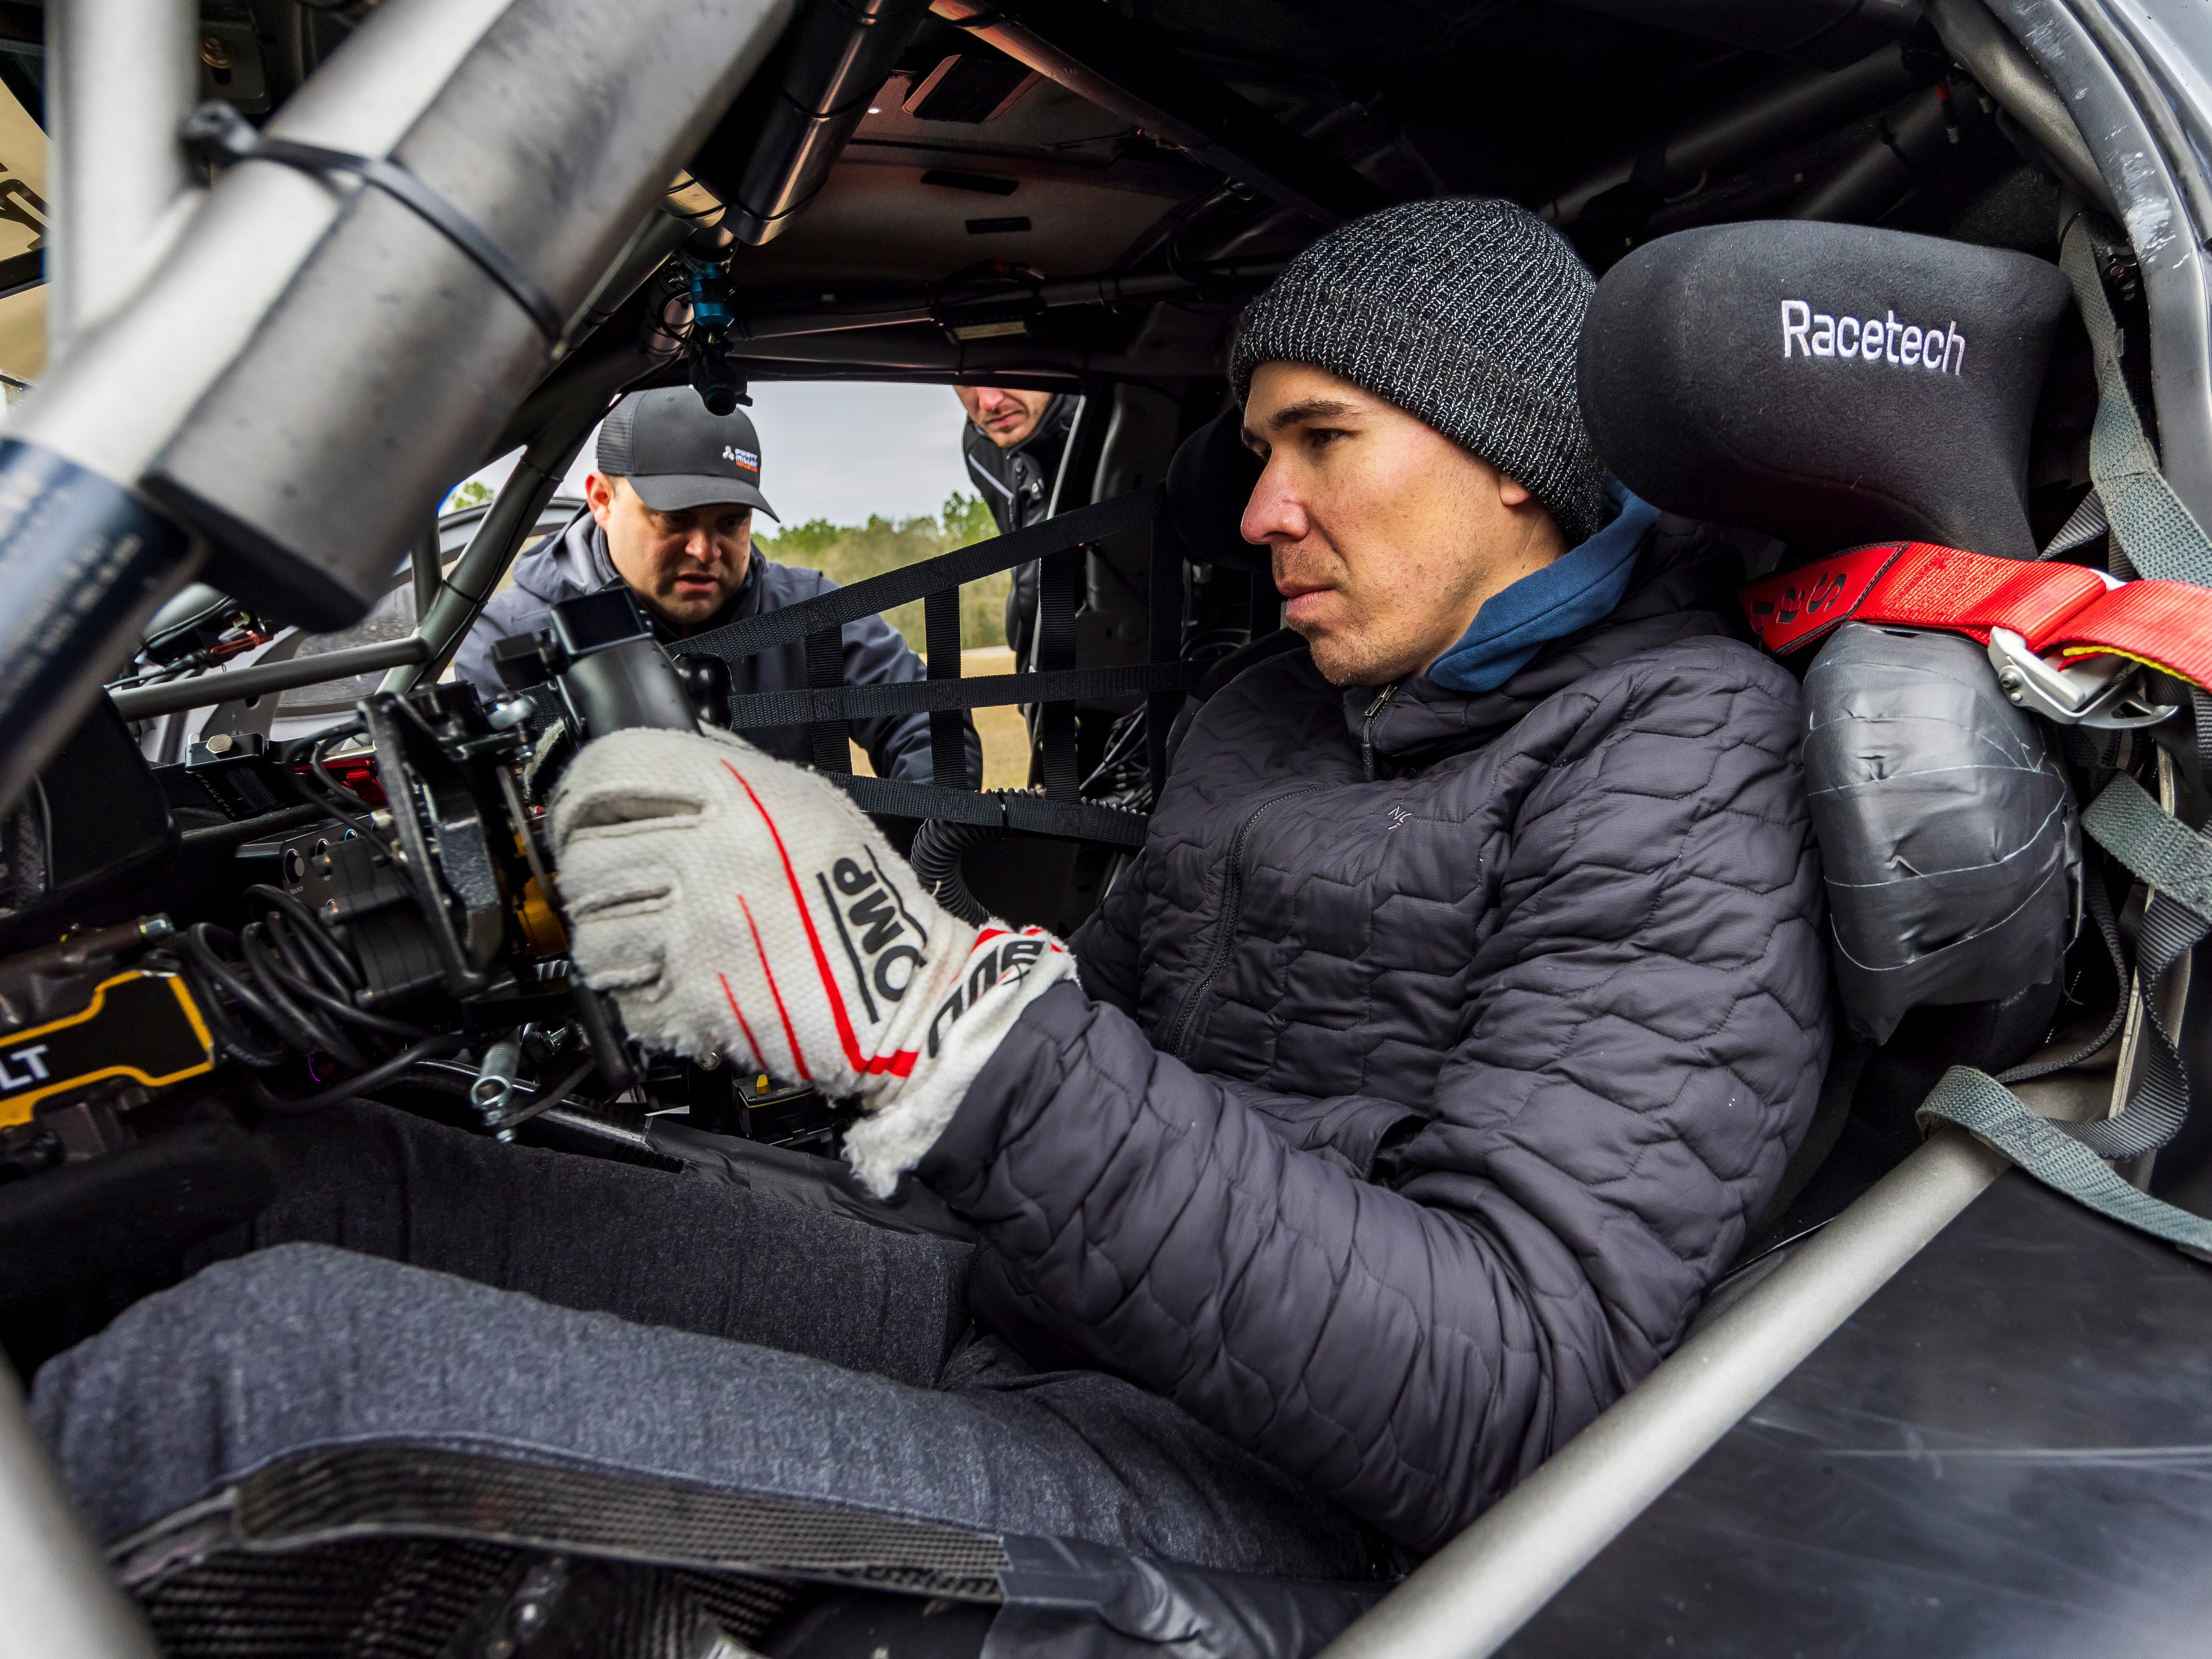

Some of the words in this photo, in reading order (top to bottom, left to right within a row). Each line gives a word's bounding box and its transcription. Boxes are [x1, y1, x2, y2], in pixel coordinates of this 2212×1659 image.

[1781, 299, 1966, 376] Racetech
[833, 857, 923, 1002] OMP
[0, 1044, 49, 1090] LT
